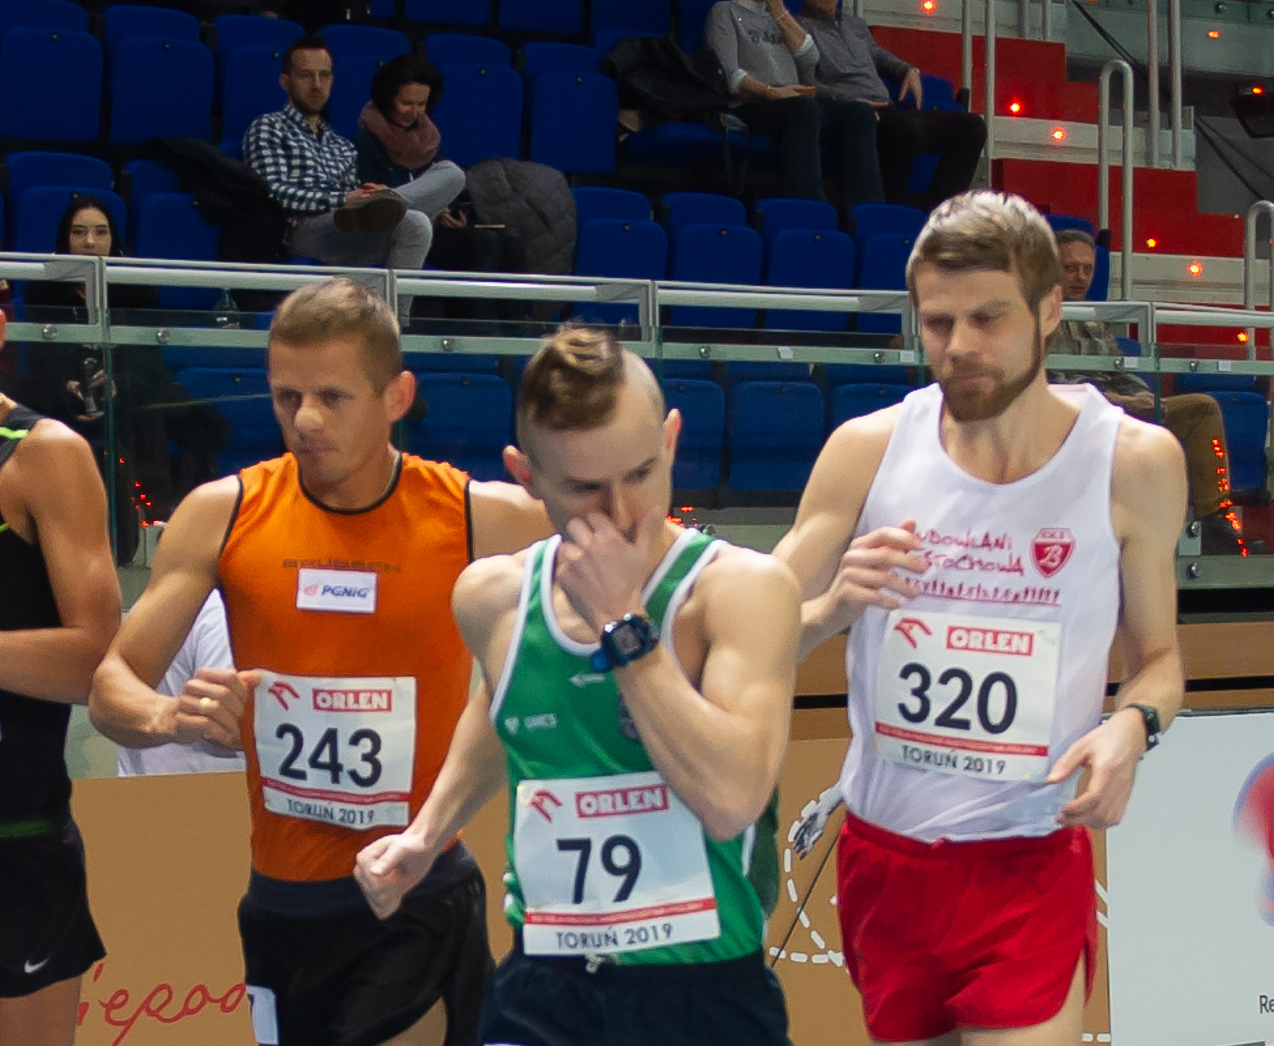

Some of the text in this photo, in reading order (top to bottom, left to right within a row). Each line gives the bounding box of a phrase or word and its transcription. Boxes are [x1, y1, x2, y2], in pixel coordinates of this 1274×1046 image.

[949, 629, 1031, 654] ORLEN
[316, 690, 389, 711] ORLEN
[897, 662, 1019, 735] 320
[275, 722, 383, 788] 243
[902, 744, 1007, 776] TORUŃ 2019
[339, 808, 374, 824] 2019
[579, 787, 665, 816] ORLEN
[556, 835, 642, 904] 79
[556, 923, 673, 950] TORUŃ 2019
